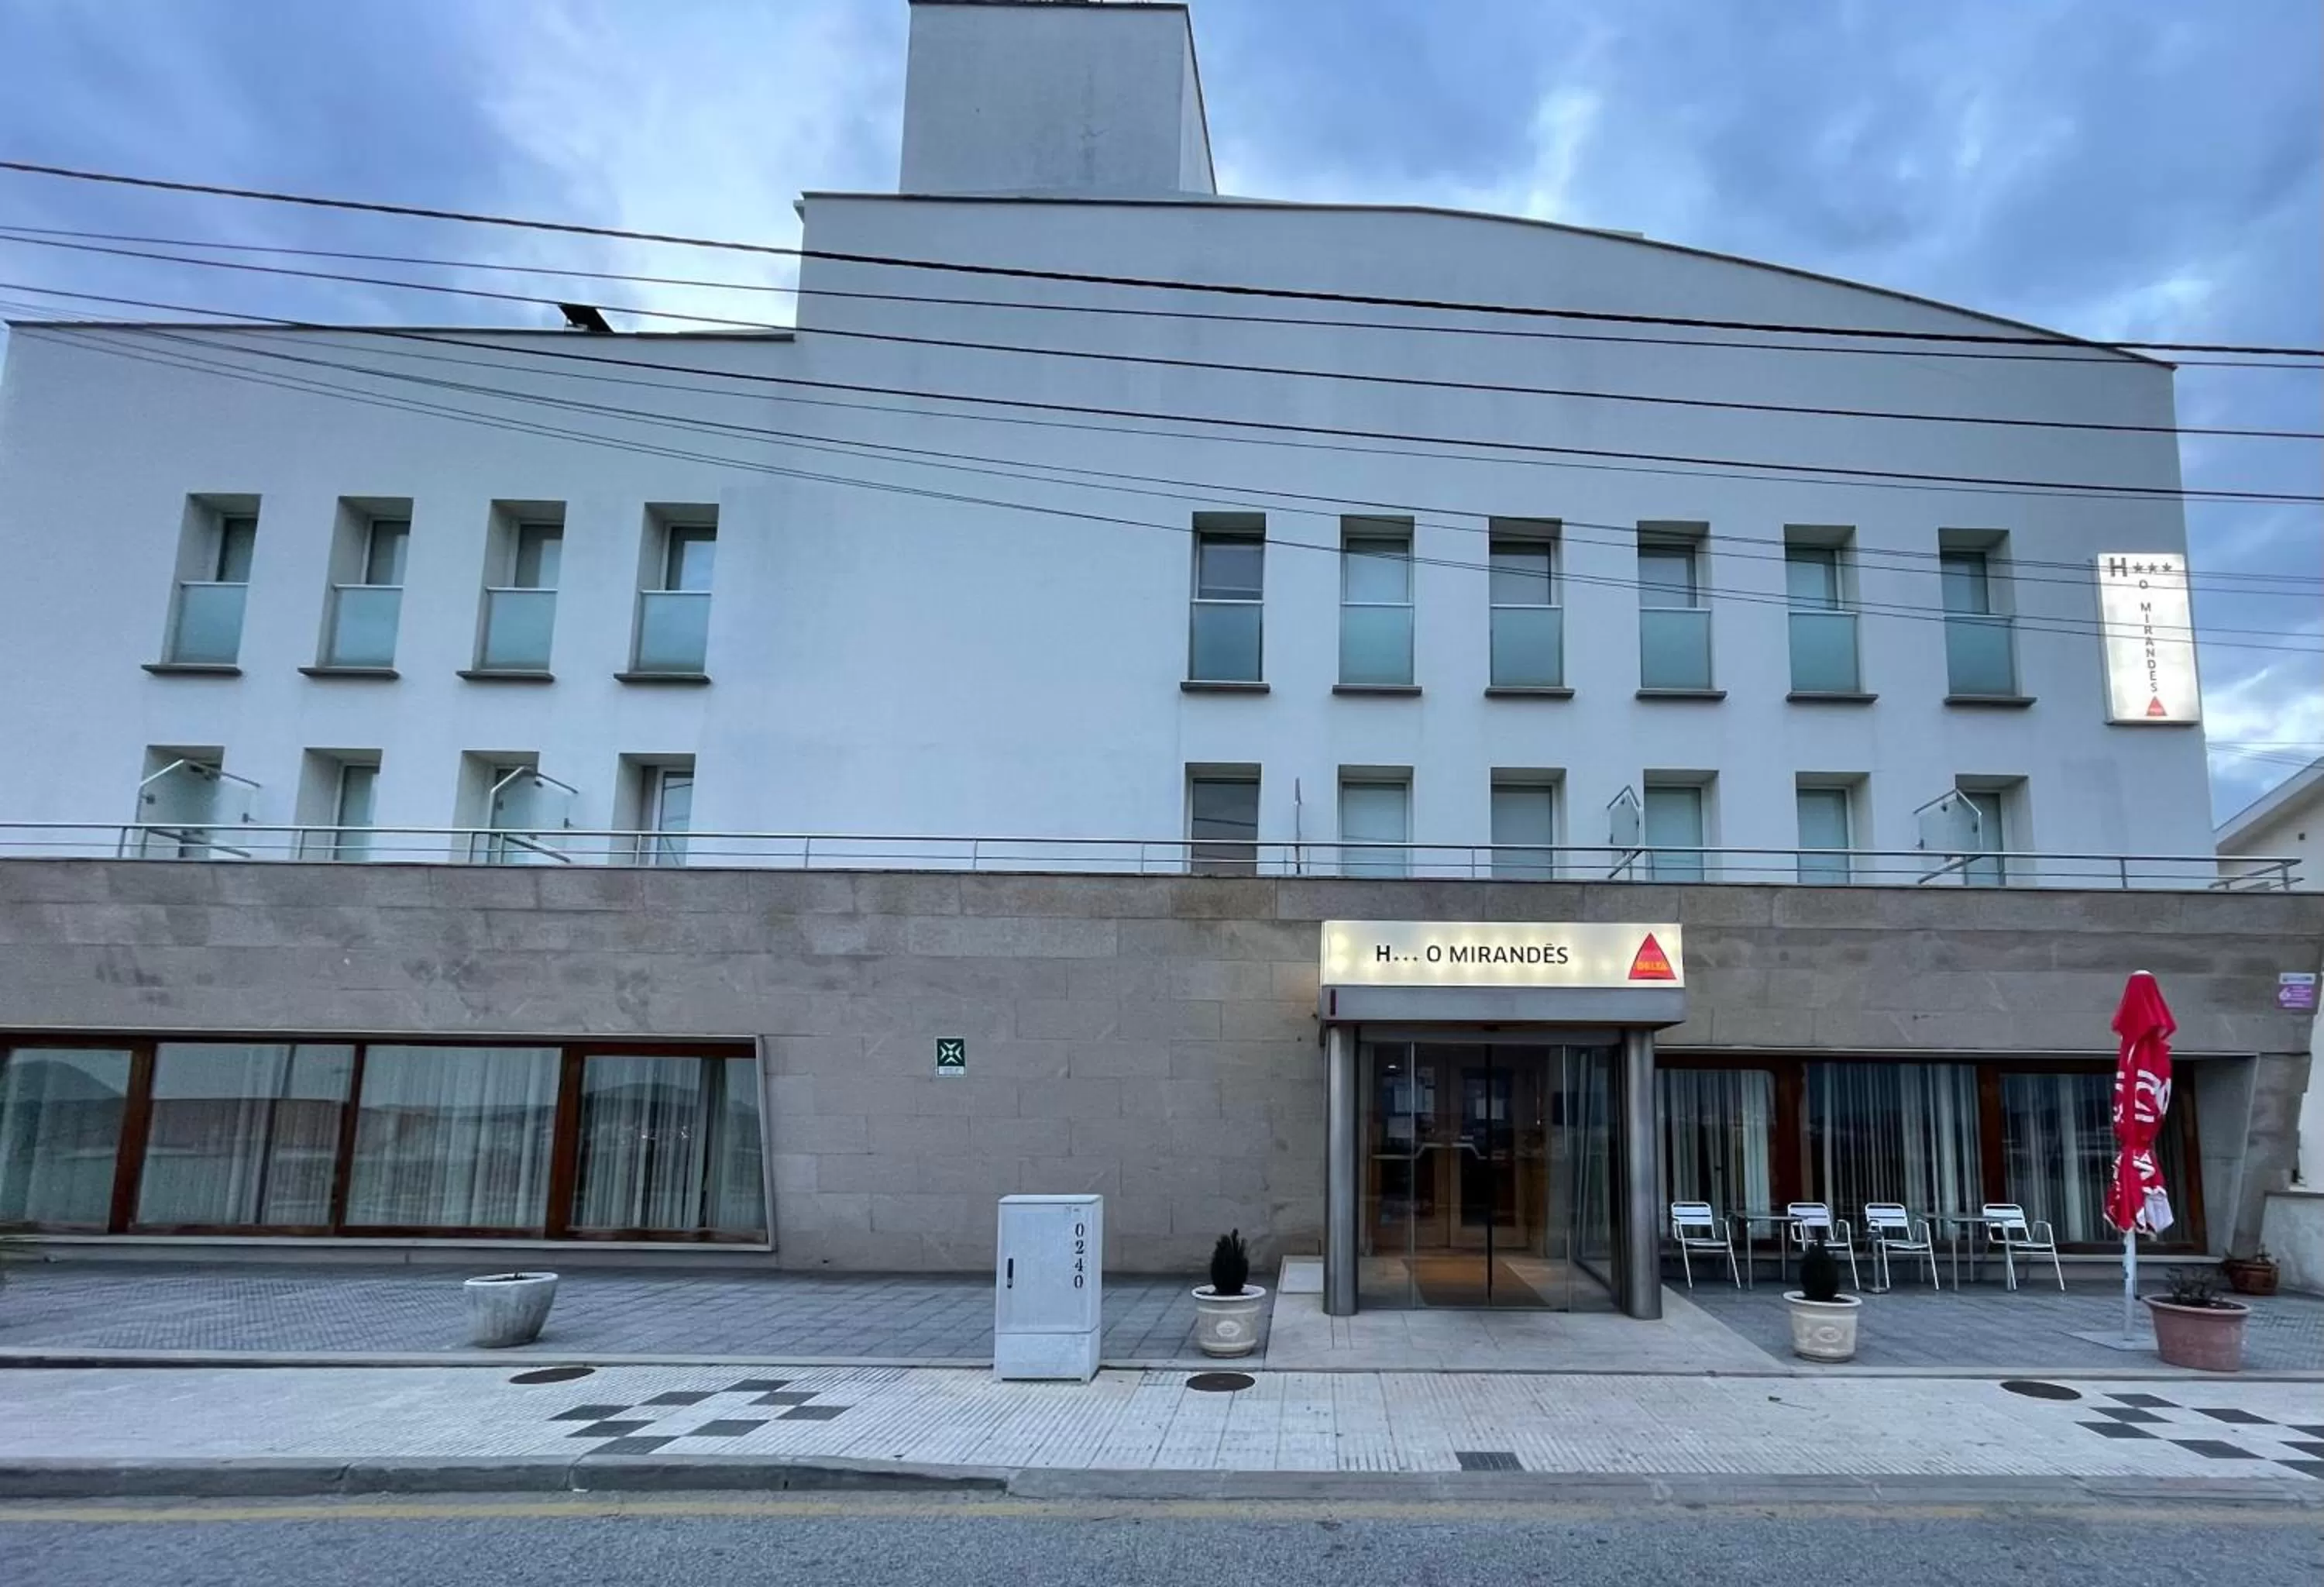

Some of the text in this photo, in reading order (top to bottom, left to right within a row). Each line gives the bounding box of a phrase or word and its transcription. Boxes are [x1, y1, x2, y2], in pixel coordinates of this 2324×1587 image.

[2138, 579, 2148, 590] O
[1426, 945, 1442, 962] O
[1074, 1222, 1085, 1289] 0240
